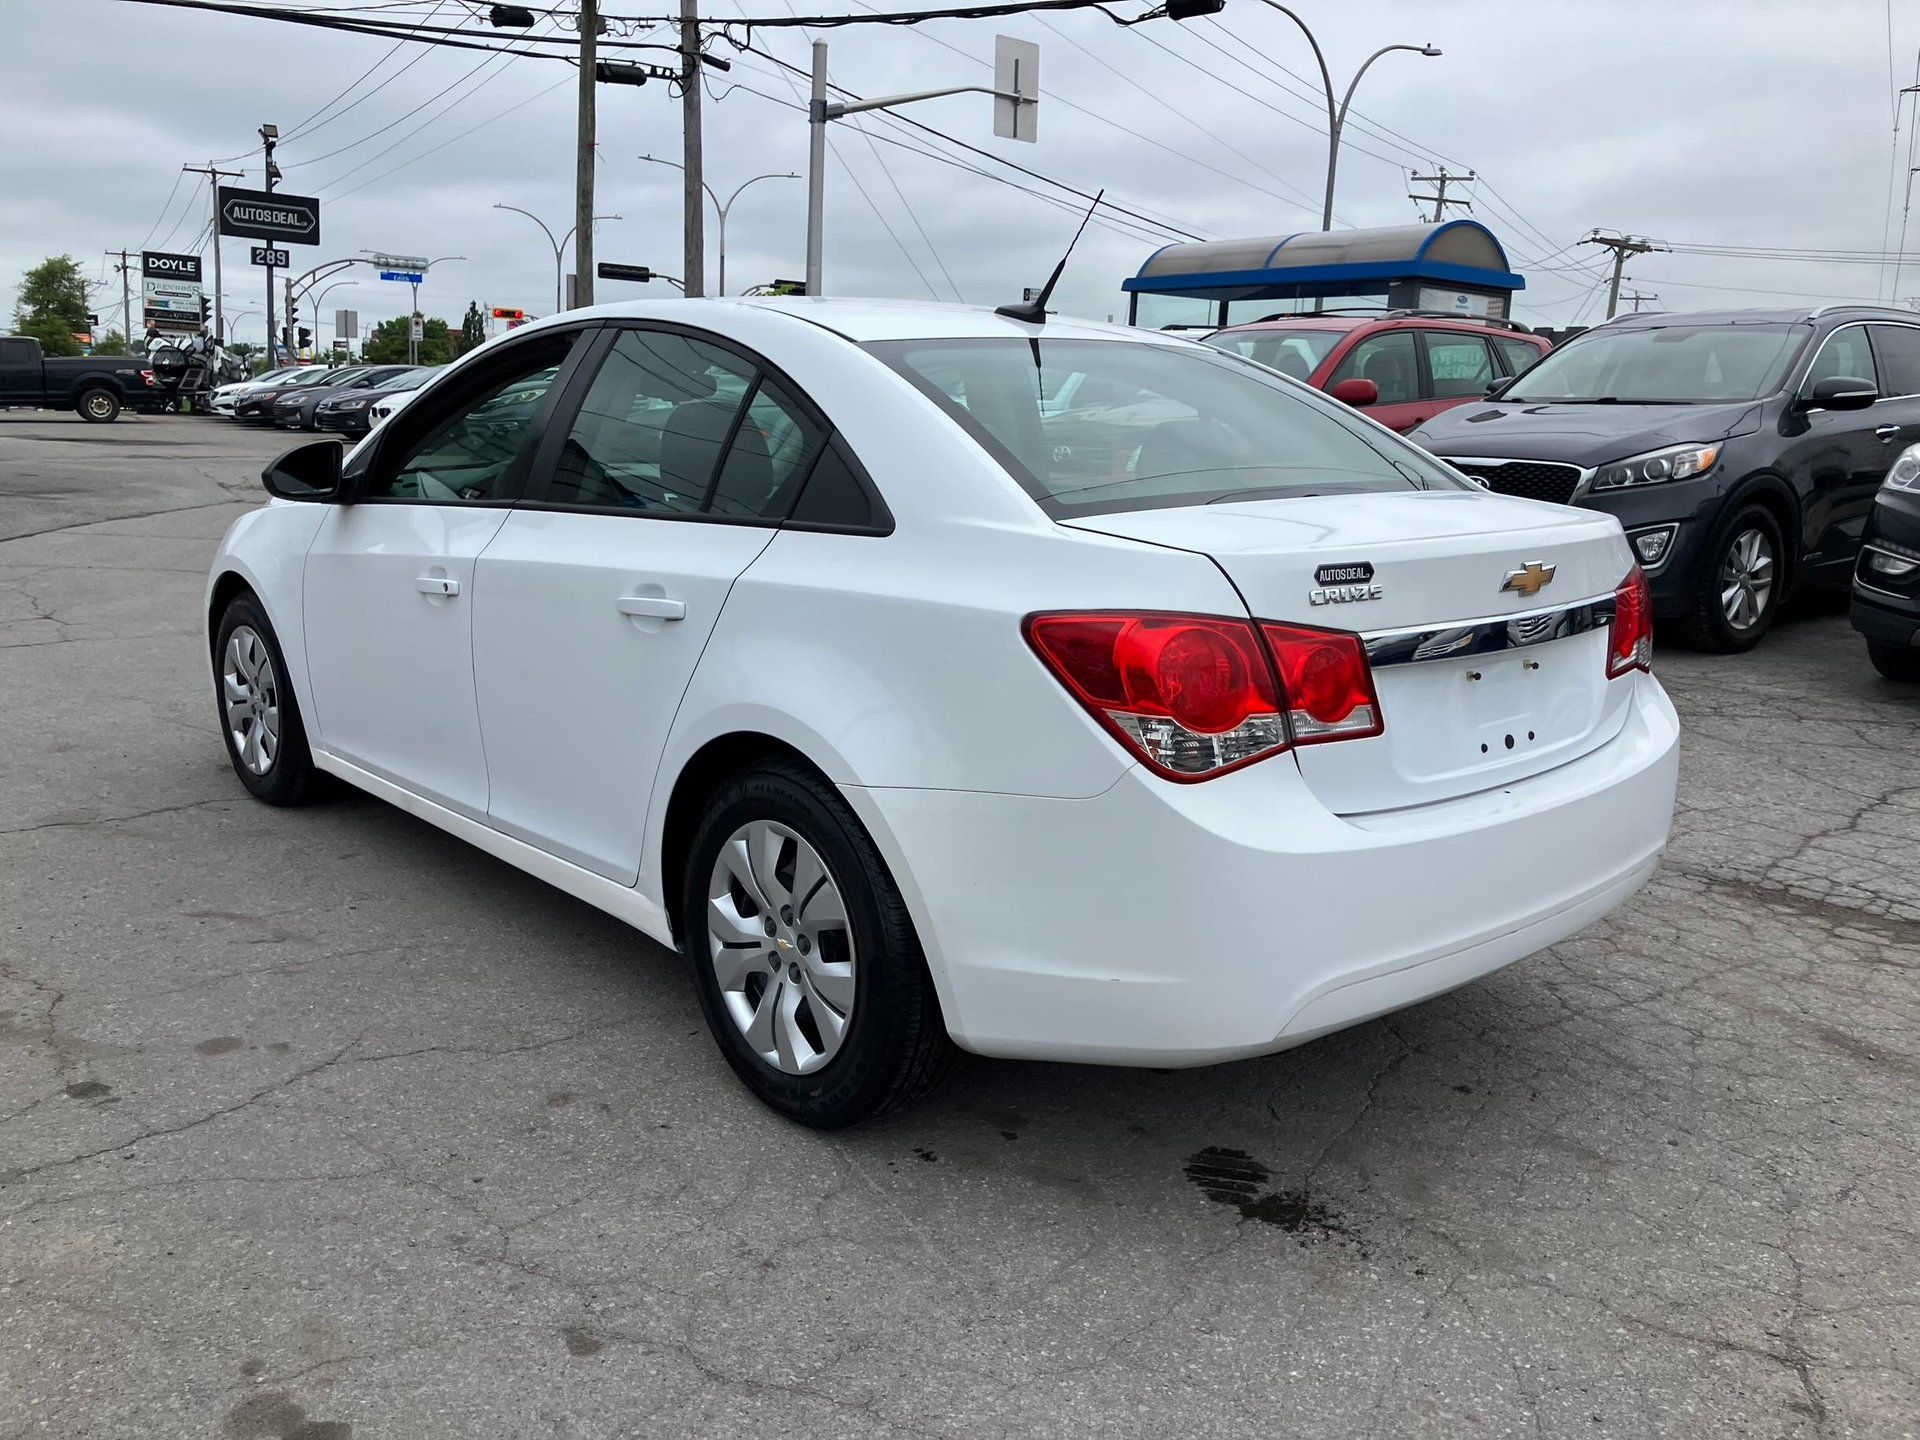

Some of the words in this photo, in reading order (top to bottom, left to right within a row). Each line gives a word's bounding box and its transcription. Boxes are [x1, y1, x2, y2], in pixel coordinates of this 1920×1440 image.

[148, 257, 196, 272] DOYLE
[255, 249, 286, 266] 289
[1309, 585, 1383, 607] CRUZE
